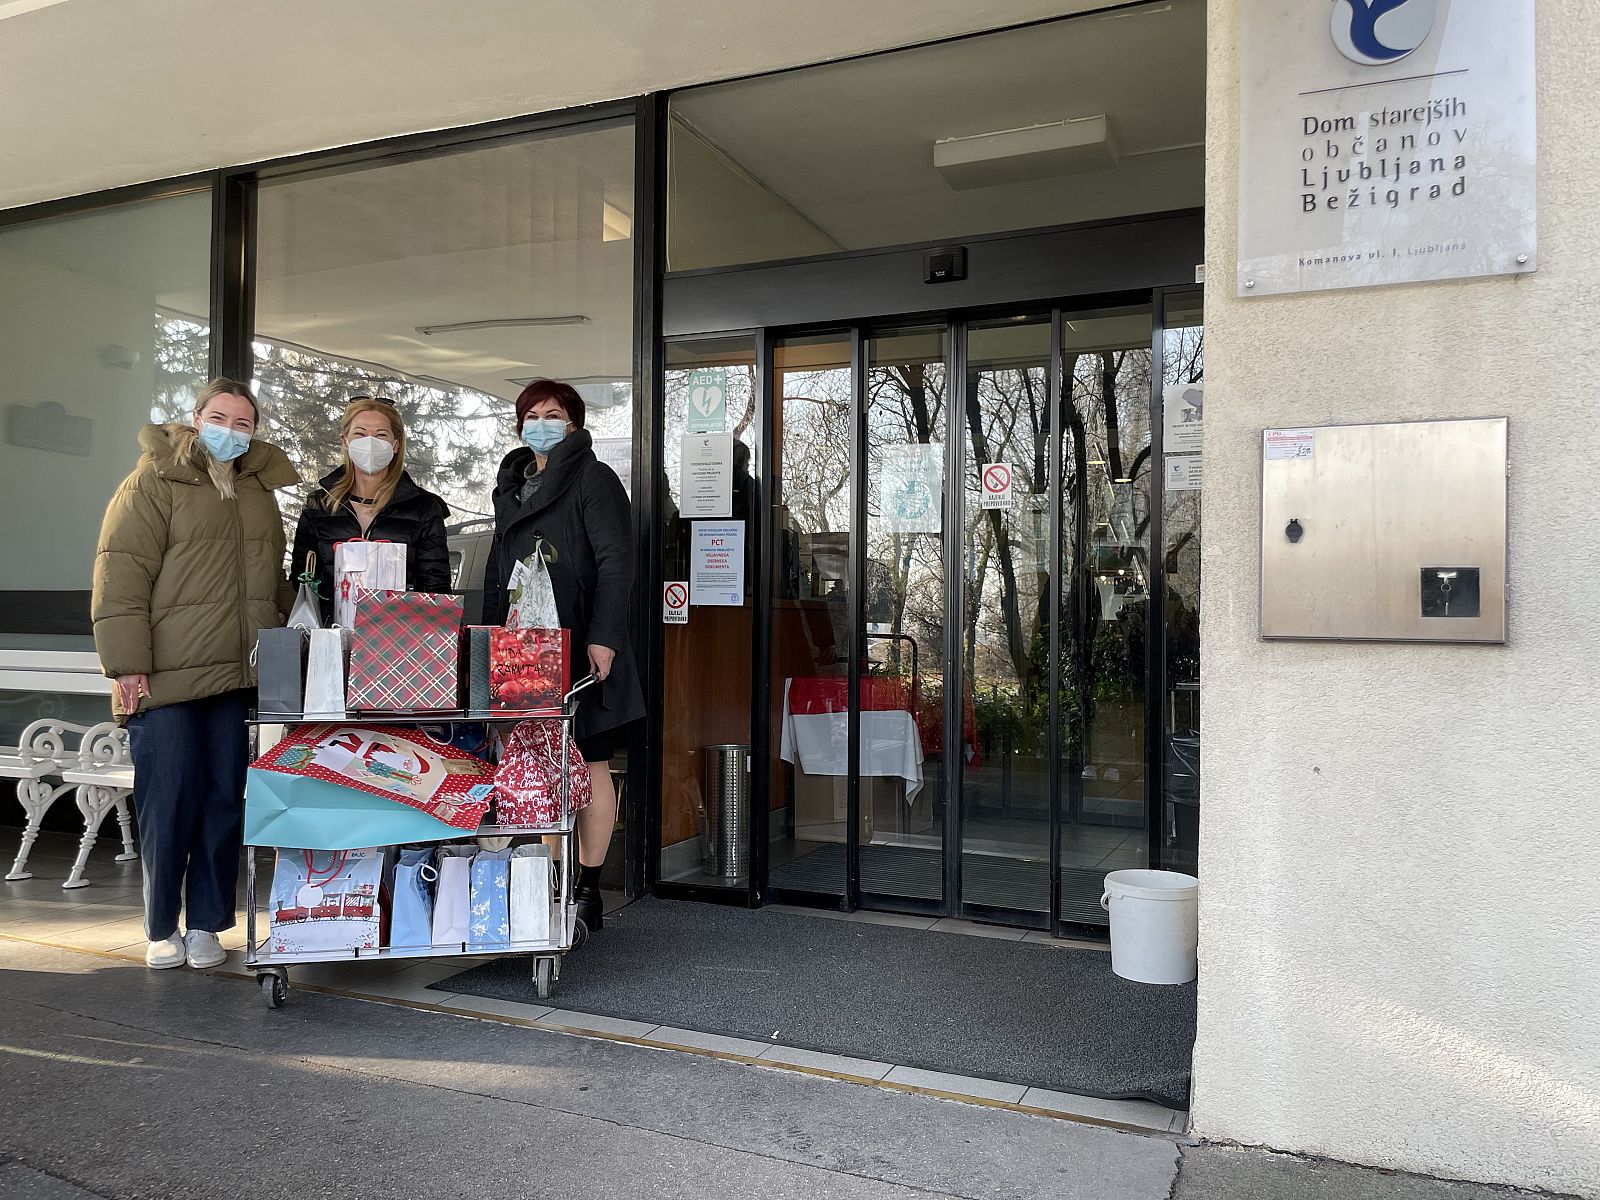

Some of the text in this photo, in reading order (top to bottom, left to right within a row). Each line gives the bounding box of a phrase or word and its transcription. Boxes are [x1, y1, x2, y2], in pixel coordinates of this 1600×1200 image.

[1301, 97, 1466, 136] Dom starejších
[1302, 128, 1468, 162] občanov
[1301, 155, 1466, 190] Ljubljana
[1301, 176, 1466, 213] Bežigrad
[1299, 254, 1361, 267] Komanova
[1368, 250, 1385, 259] ul.
[1407, 243, 1466, 256] Ljubljana
